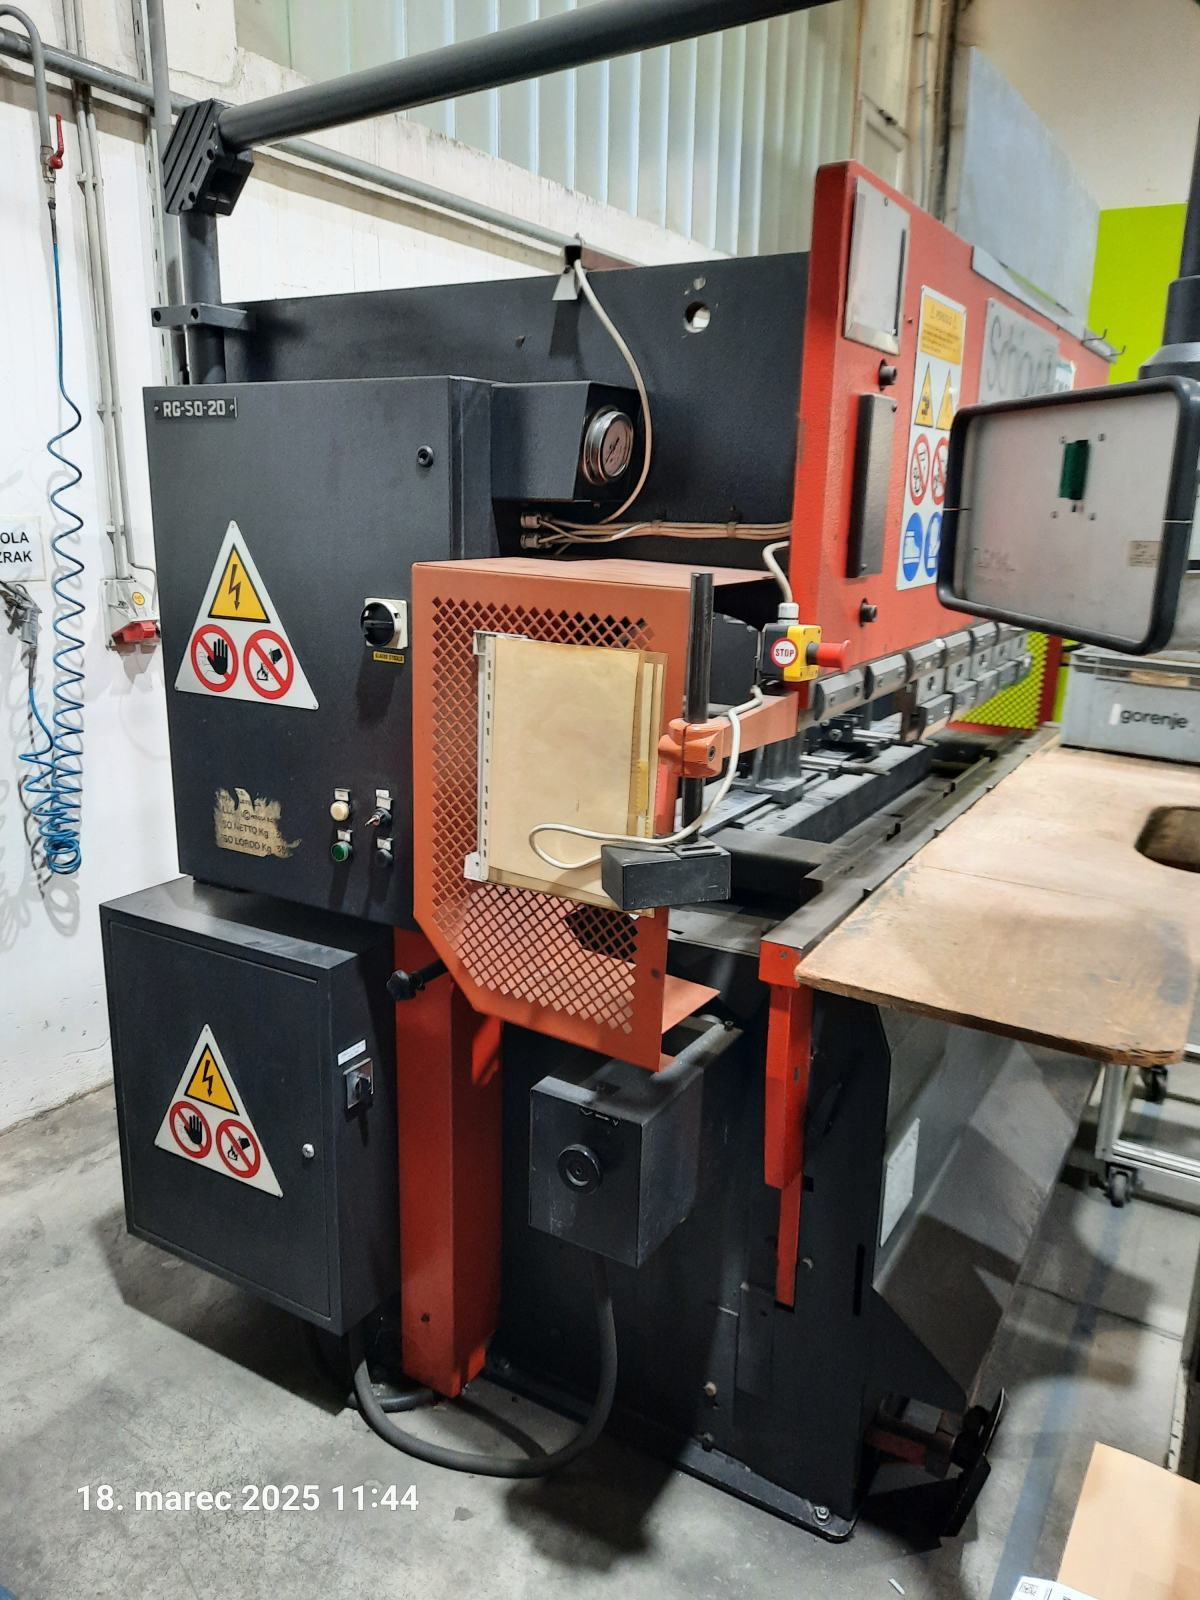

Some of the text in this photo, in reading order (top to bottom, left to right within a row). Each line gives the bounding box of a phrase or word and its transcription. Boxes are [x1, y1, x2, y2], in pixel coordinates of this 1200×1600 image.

[775, 648, 795, 657] STOP
[1120, 710, 1188, 730] gorenje
[234, 837, 261, 850] LORDO
